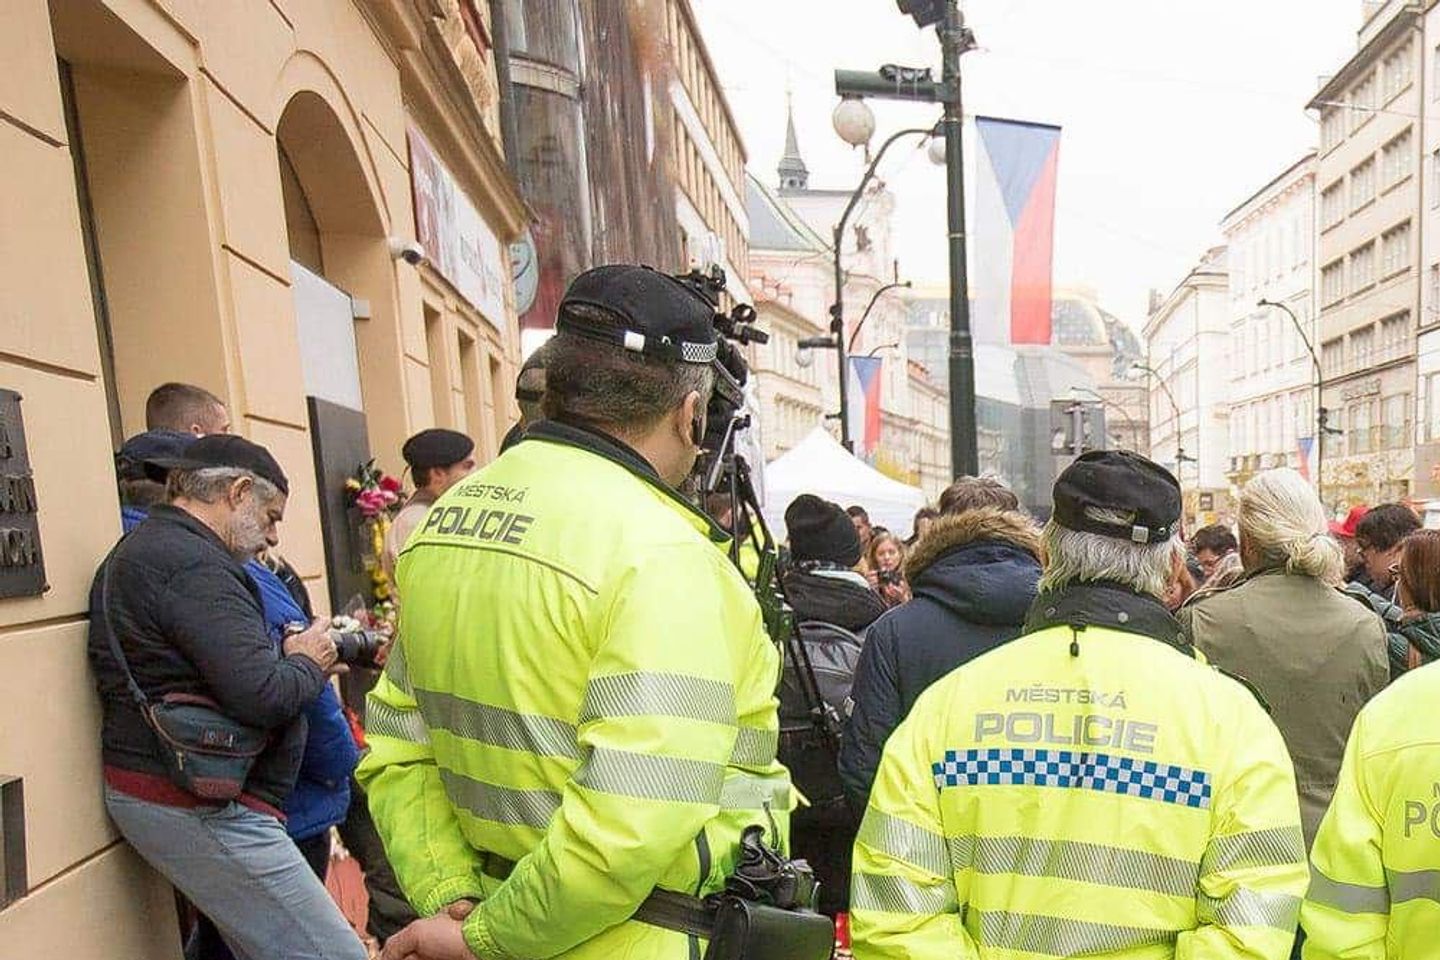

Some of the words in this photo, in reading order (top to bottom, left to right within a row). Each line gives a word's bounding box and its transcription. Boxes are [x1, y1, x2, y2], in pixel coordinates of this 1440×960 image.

[421, 505, 535, 545] POLICIE
[1005, 683, 1128, 709] MĚSTSKÁ
[974, 712, 1158, 754] POLICIE
